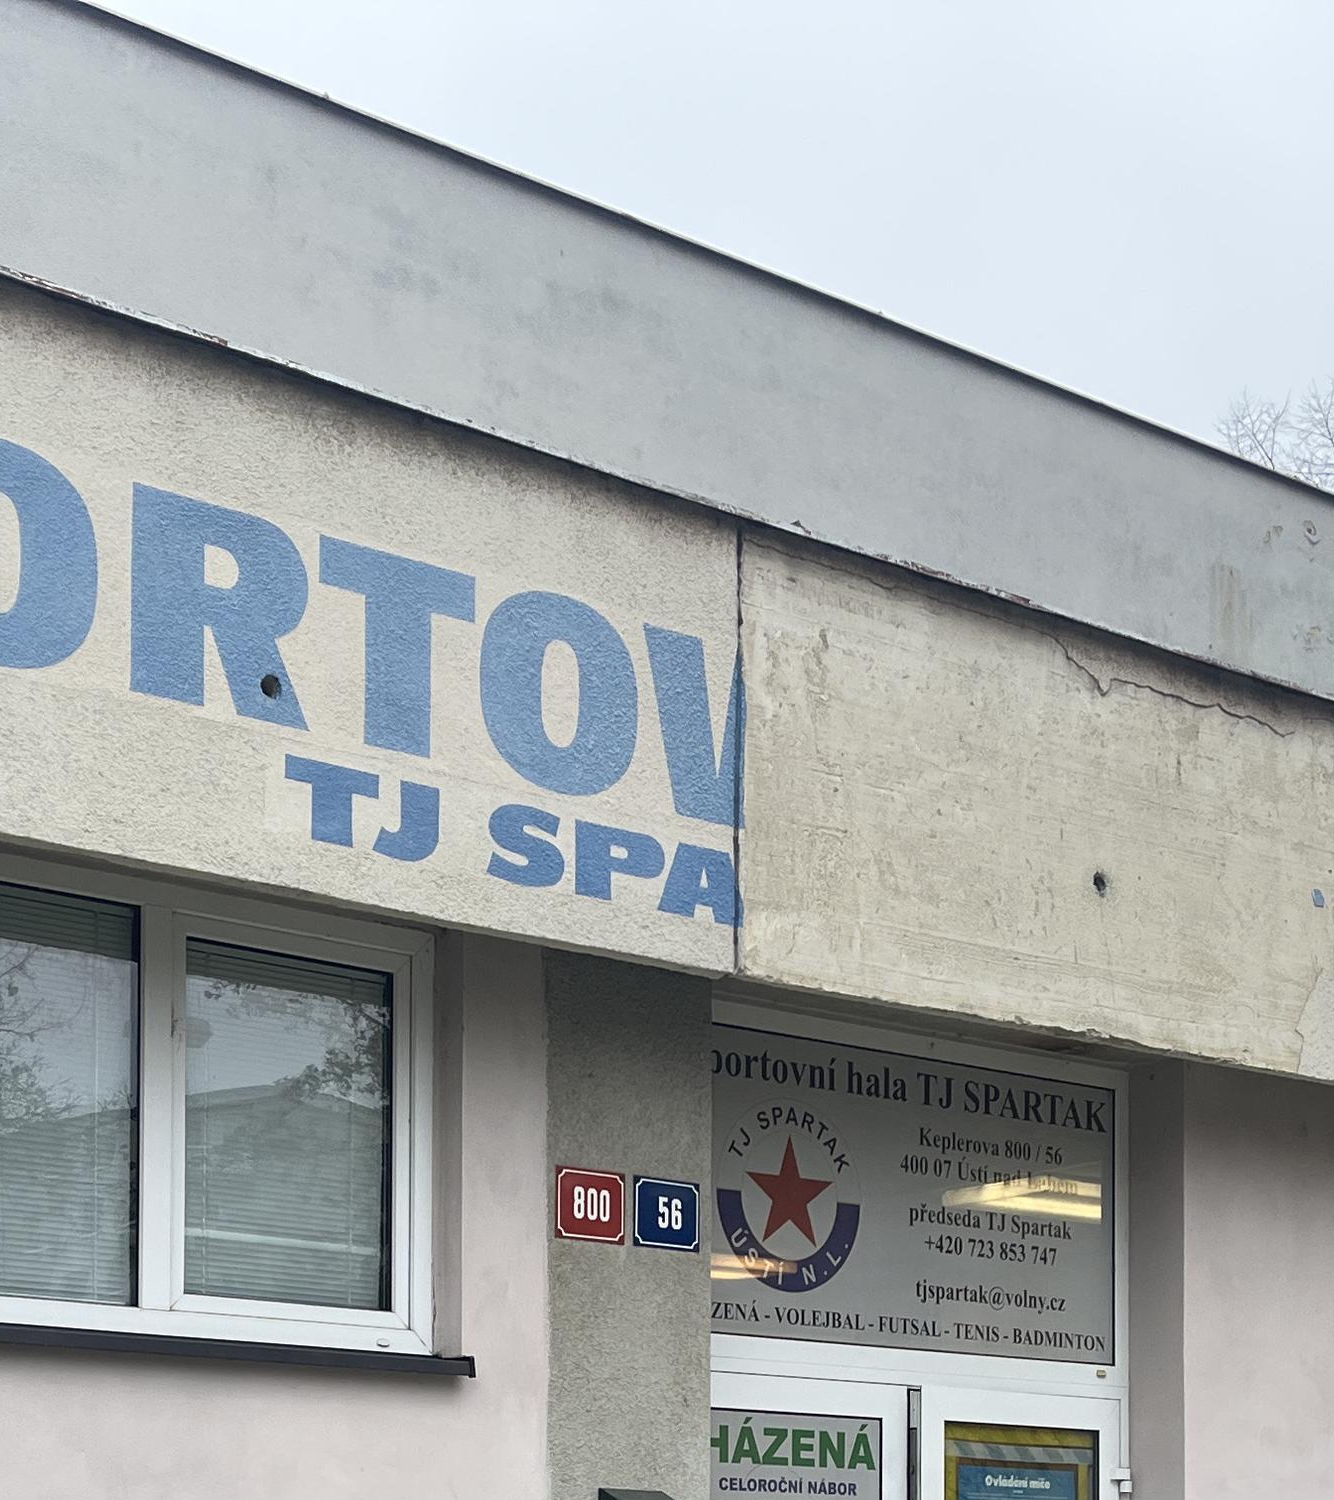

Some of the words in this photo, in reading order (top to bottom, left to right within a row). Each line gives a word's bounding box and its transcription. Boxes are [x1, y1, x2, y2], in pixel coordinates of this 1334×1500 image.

[284, 753, 440, 863] TJ
[487, 803, 744, 929] SPA
[847, 1061, 908, 1102] hala
[917, 1072, 955, 1110] TJ
[964, 1080, 1107, 1133] SPARTAK
[728, 1127, 751, 1158] TJ
[757, 1106, 850, 1174] SPARTAK
[919, 1127, 1000, 1156] Keplerova
[1004, 1139, 1032, 1161] 800
[1045, 1146, 1063, 1166] 56
[900, 1154, 929, 1175] 400
[933, 1158, 952, 1179] 07
[958, 1156, 989, 1184] Ústí
[573, 1186, 611, 1222] 800
[658, 1196, 682, 1230] 56
[909, 1203, 981, 1229] předseda
[985, 1212, 1007, 1233] TJ
[1011, 1215, 1073, 1240] Spartak
[731, 1227, 785, 1286] ÚSTÍ
[924, 1234, 963, 1256] +420
[968, 1238, 995, 1259] 723
[1000, 1242, 1026, 1263] 853
[1031, 1246, 1057, 1266] 747
[916, 1279, 1066, 1315] tjspartak@volny.cz
[774, 1306, 865, 1331] VOLEJBAL
[878, 1315, 941, 1337] FUTSAL
[954, 1323, 1000, 1343] TENIS
[1013, 1327, 1106, 1352] BADMINTON
[719, 1476, 803, 1494] CELOROČNÍ
[808, 1478, 857, 1497] NÁBOR
